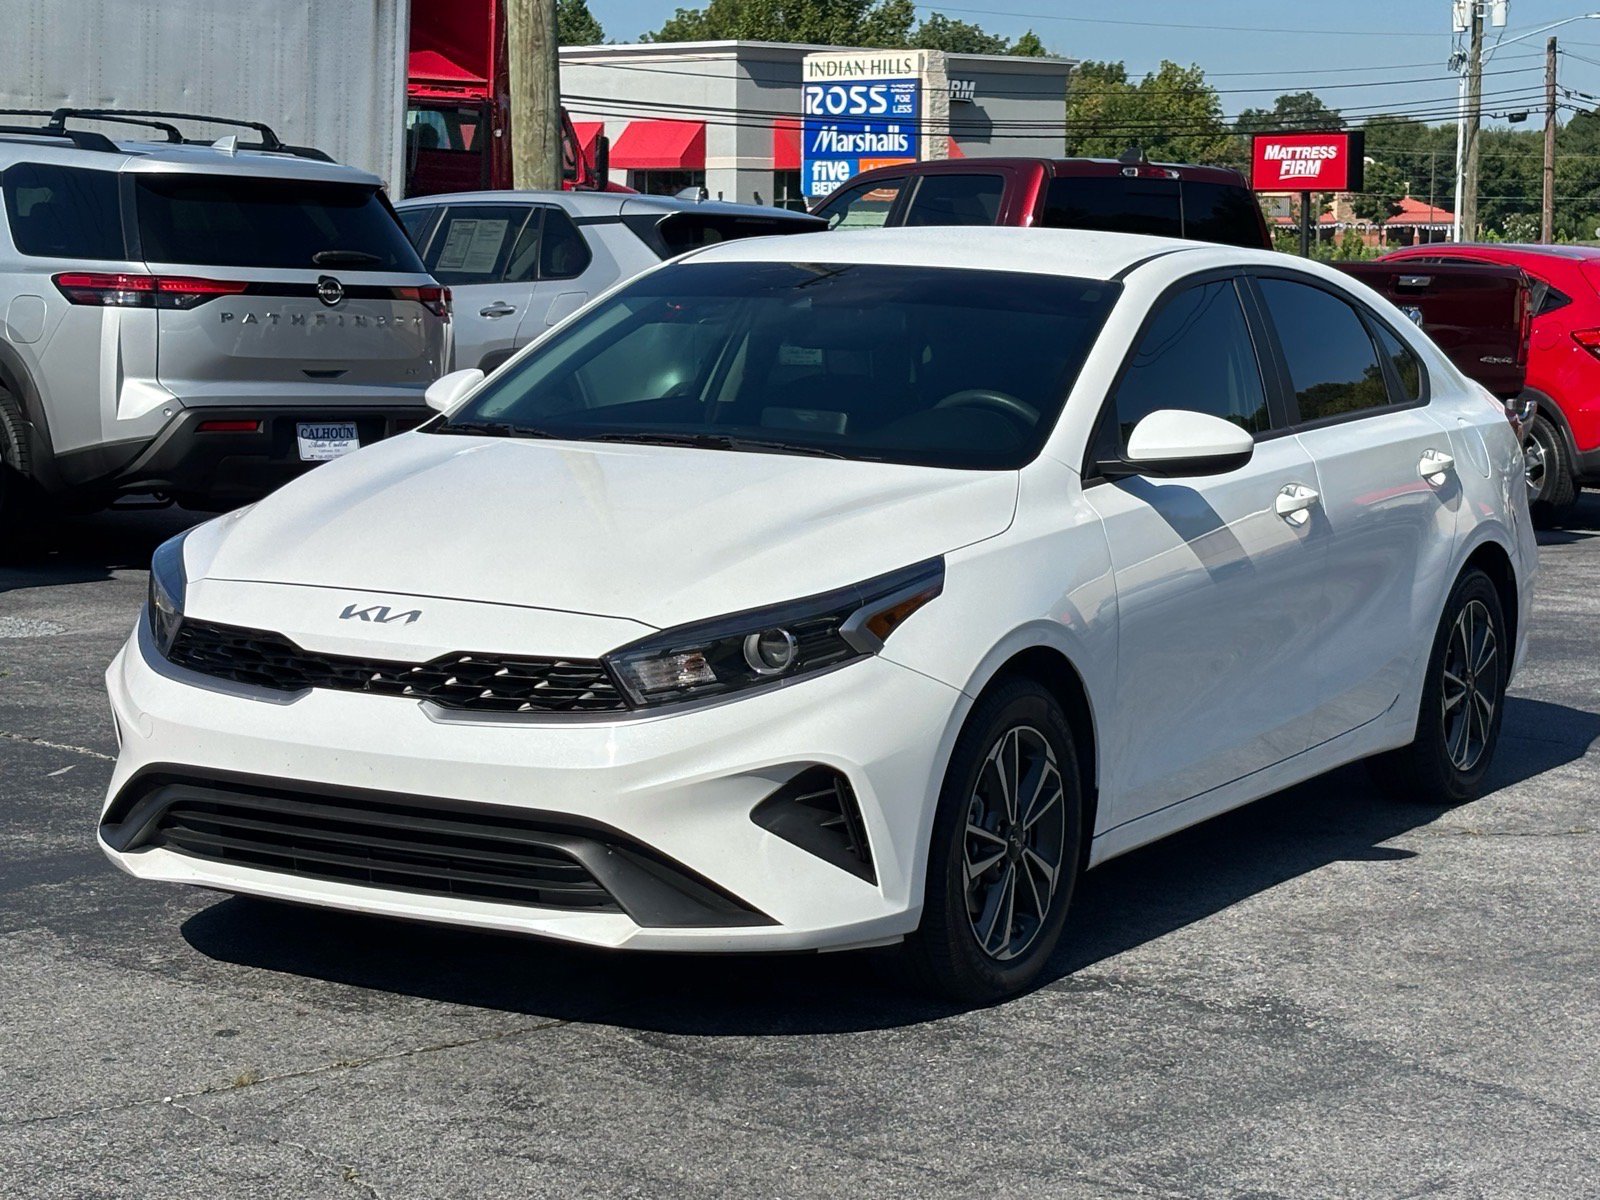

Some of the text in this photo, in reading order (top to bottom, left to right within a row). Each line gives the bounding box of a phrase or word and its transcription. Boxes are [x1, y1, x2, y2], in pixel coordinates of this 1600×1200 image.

[809, 58, 912, 77] INDIAN HILLS
[806, 85, 888, 115] ROSS
[894, 94, 911, 103] FOR
[892, 104, 913, 113] LESS
[812, 125, 908, 152] Marshalls
[1264, 145, 1337, 159] MATTRESS
[812, 161, 850, 181] five
[1279, 160, 1322, 175] FIRM
[300, 427, 354, 439] CALHOUN
[339, 603, 422, 625] KIA
